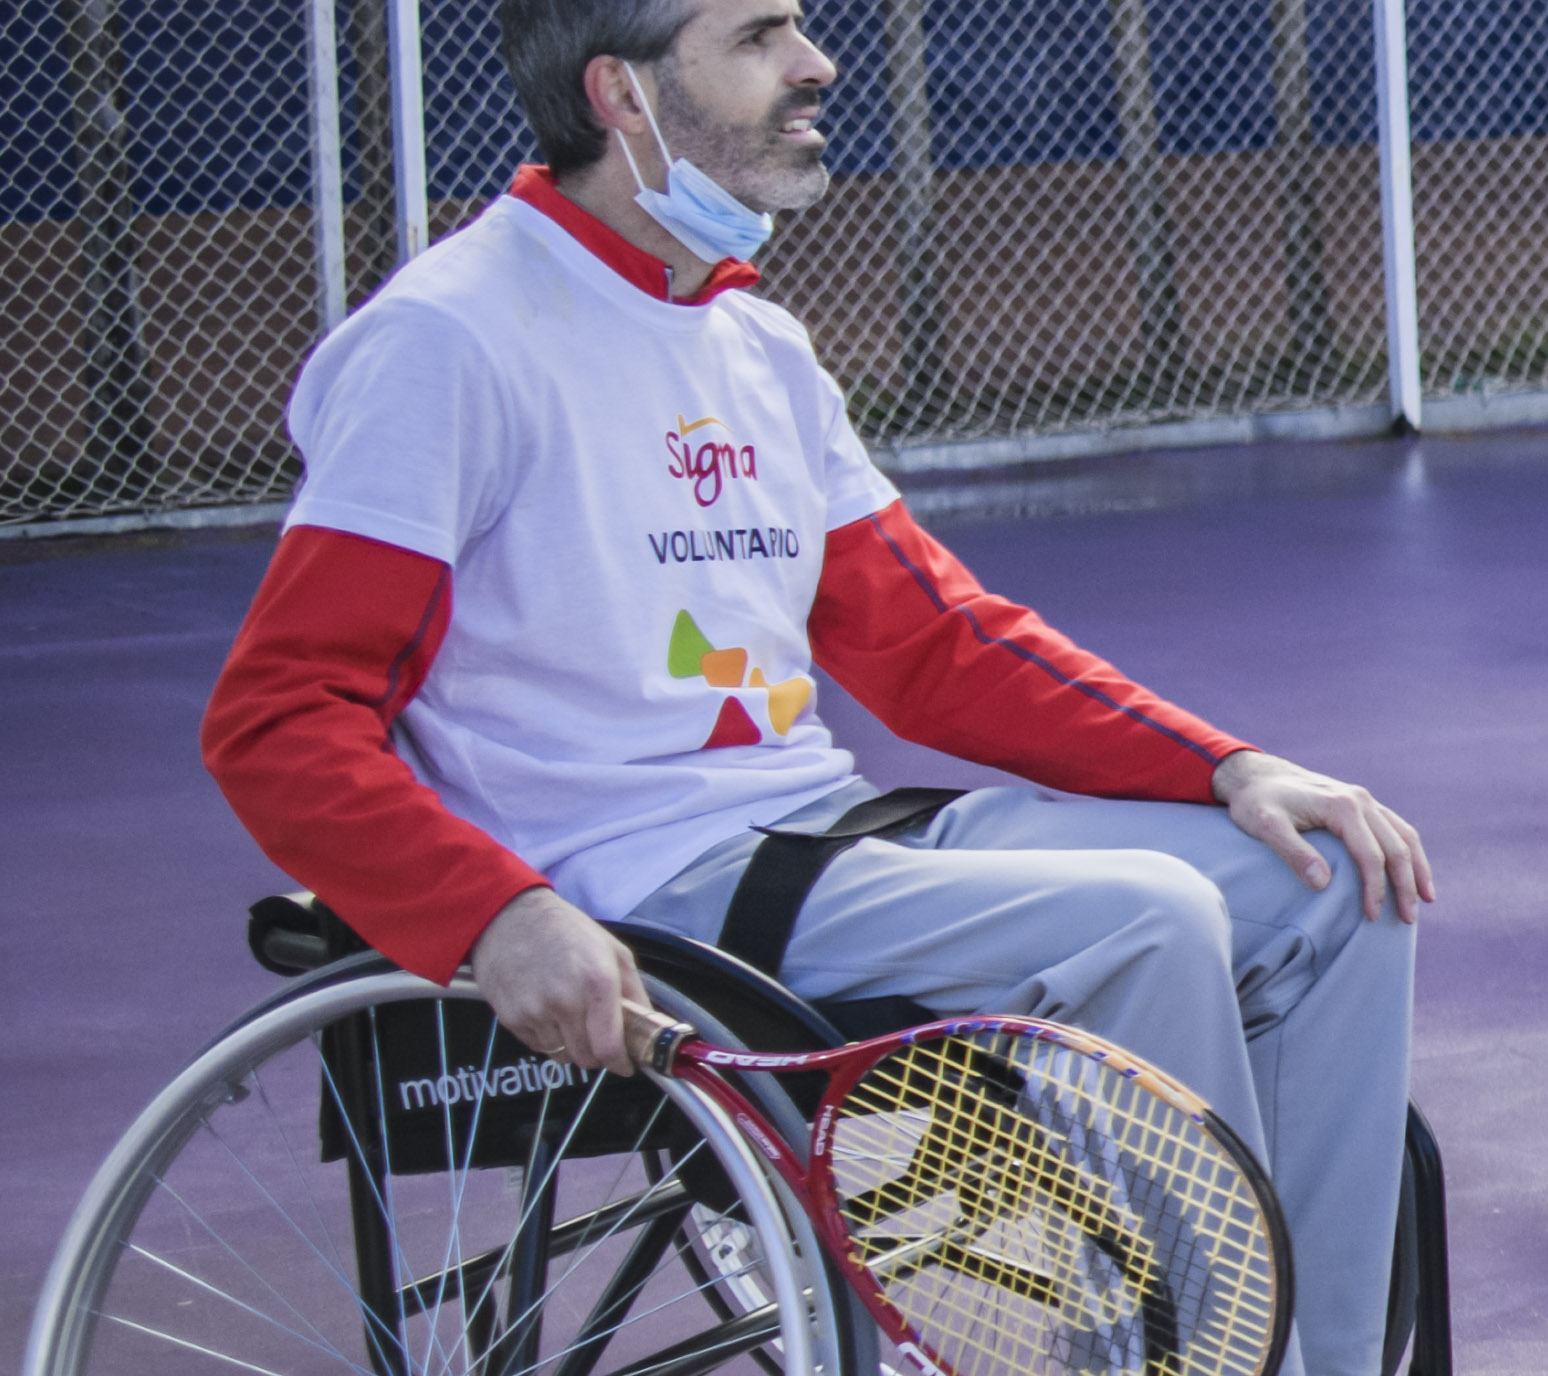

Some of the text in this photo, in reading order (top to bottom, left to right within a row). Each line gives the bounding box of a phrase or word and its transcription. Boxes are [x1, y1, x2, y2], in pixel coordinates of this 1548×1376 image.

[665, 422, 758, 508] Sigma
[648, 528, 800, 564] VOLUNTARIO
[399, 1056, 590, 1111] motivation
[704, 1049, 810, 1067] HEAD
[813, 1104, 836, 1156] HEAD
